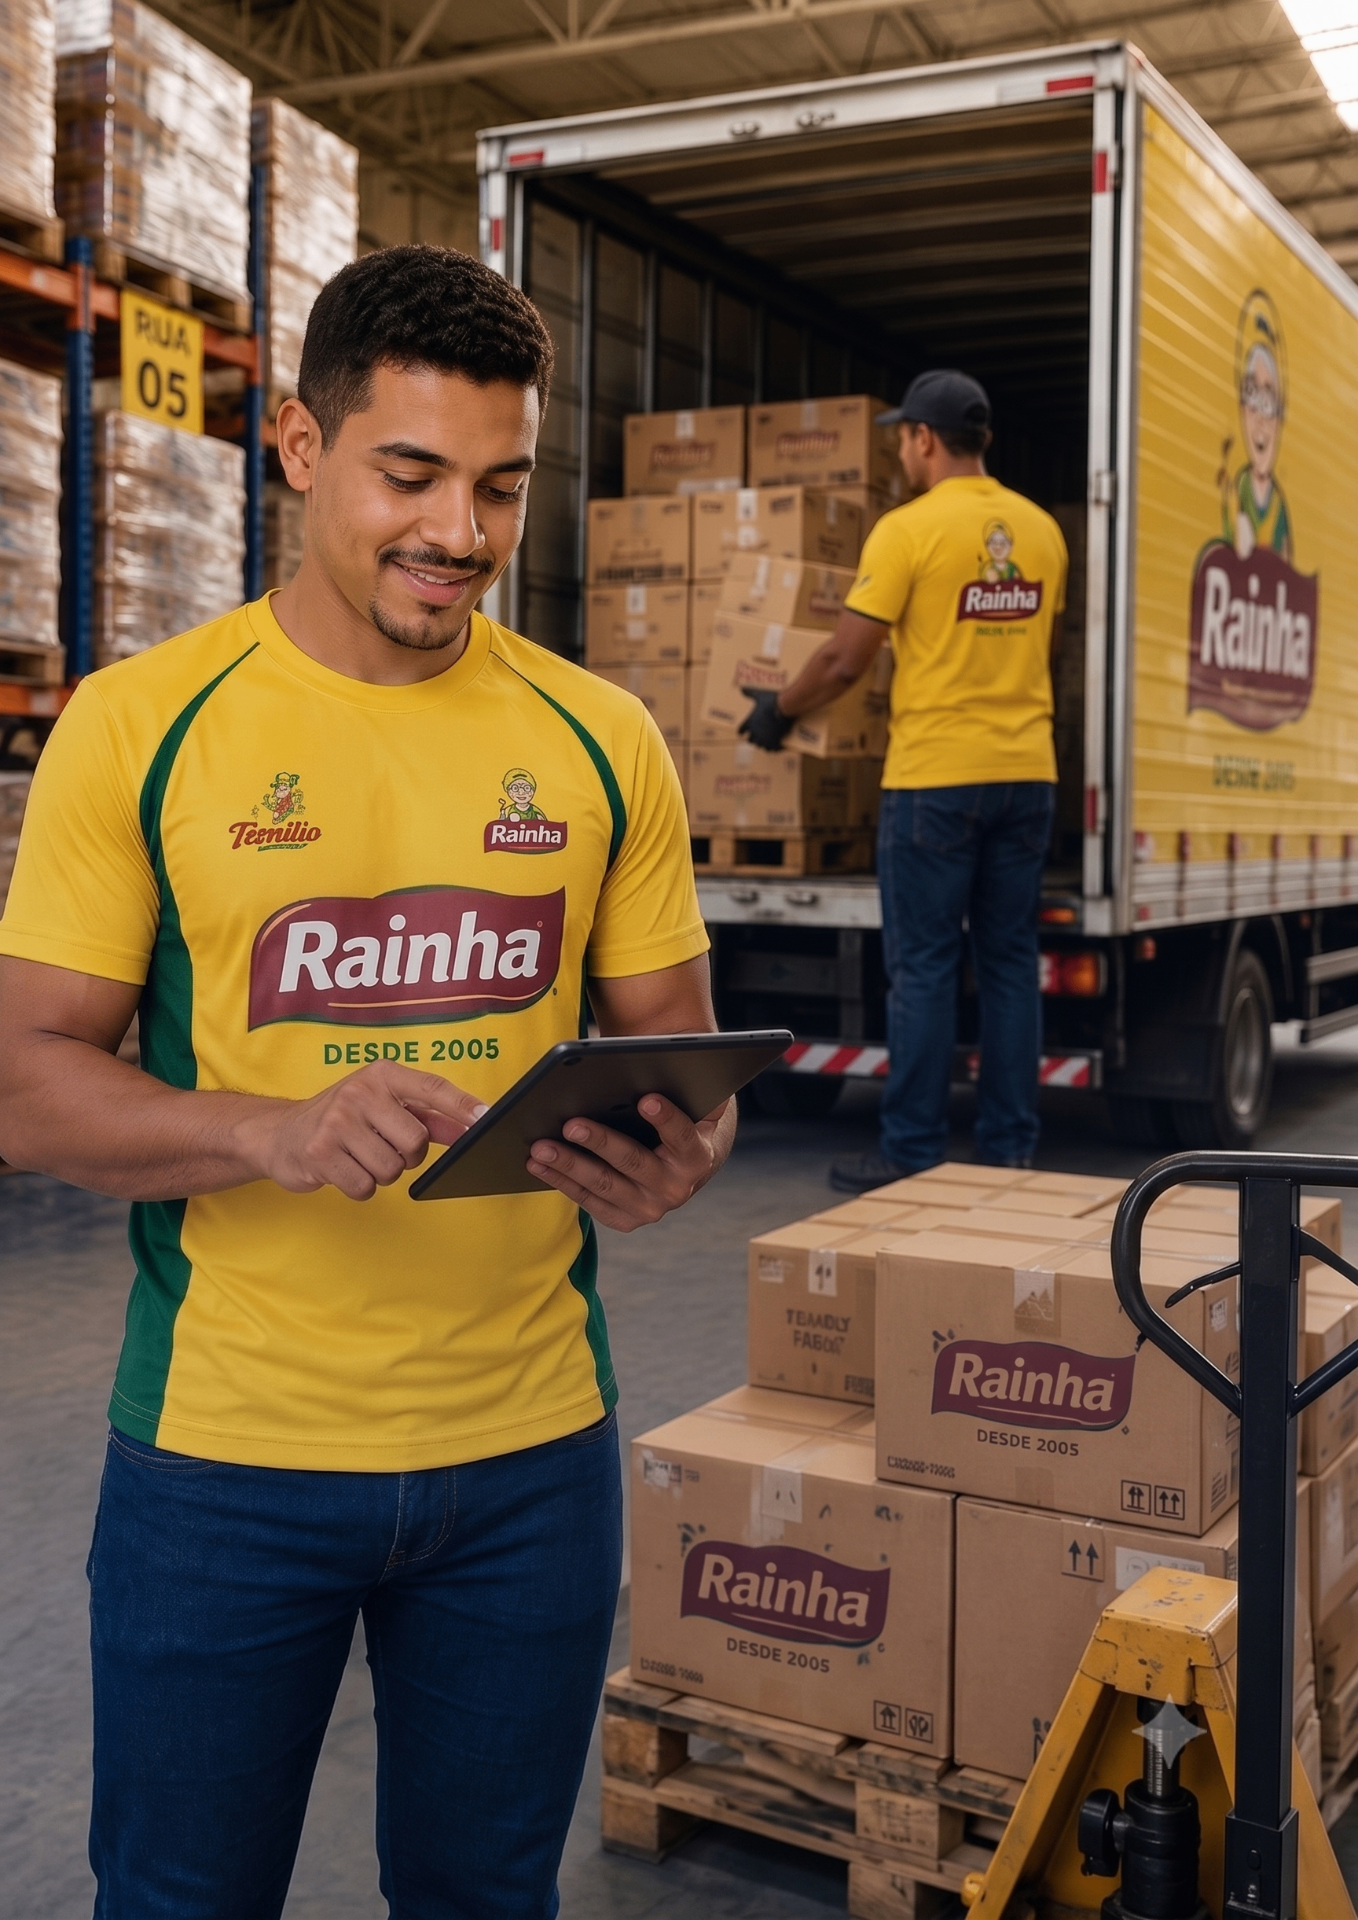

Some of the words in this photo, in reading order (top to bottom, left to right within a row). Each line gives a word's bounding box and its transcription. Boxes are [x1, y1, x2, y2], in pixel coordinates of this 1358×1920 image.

[135, 308, 192, 356] RUA
[139, 360, 187, 418] 05
[964, 584, 1038, 613] Rainha
[1200, 565, 1311, 680] Rainha
[491, 823, 562, 845] Rainha
[279, 910, 541, 993] Rainha
[323, 1041, 419, 1065] DESDE
[431, 1038, 500, 1061] 2005
[948, 1352, 1116, 1412] Rainha
[976, 1428, 1031, 1450] DESDE
[1036, 1438, 1080, 1457] 2005
[698, 1553, 870, 1627] Rainha
[726, 1637, 782, 1662] DESDE
[787, 1650, 831, 1673] 2005
